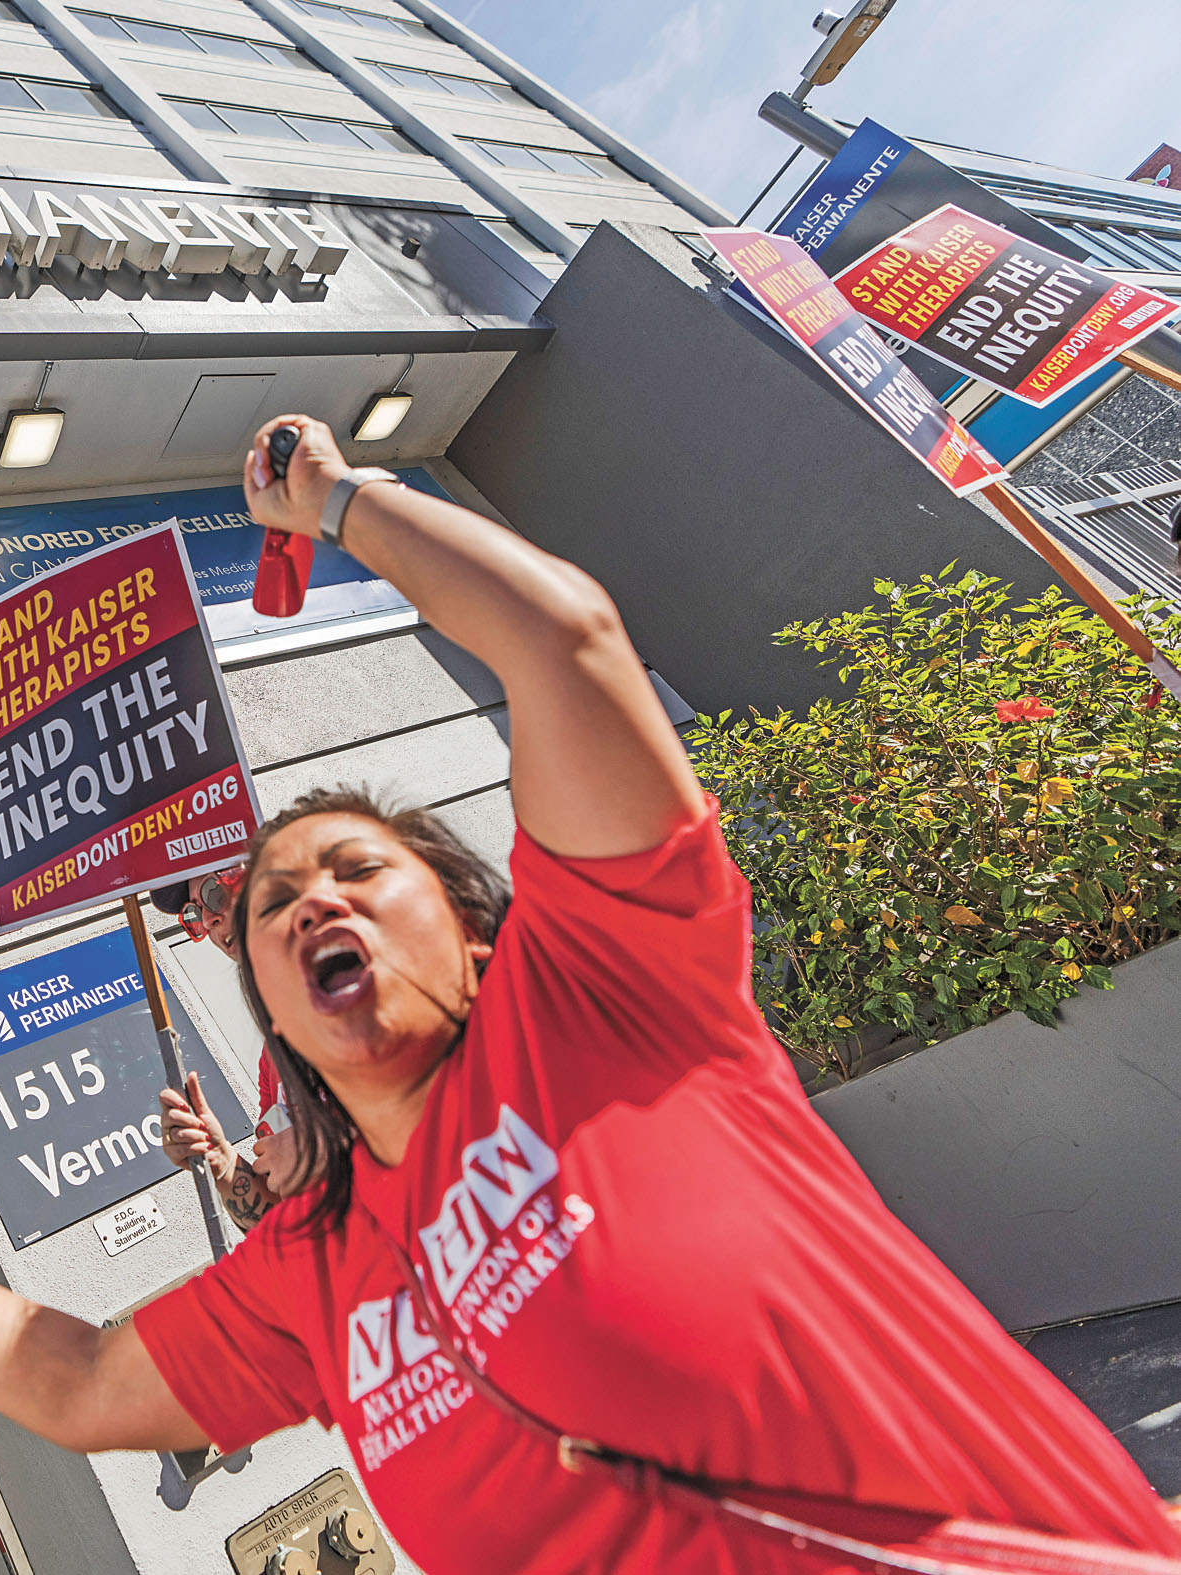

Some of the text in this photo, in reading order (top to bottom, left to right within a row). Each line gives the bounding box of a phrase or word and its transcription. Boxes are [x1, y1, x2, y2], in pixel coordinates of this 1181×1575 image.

[802, 145, 900, 254] PERMANENTE
[731, 239, 782, 277] STAND
[851, 246, 913, 303] STAND
[873, 223, 978, 317] WITH KAISER
[897, 240, 996, 331] THERAPISTS
[757, 269, 804, 307] WITH
[936, 253, 1048, 351] END THE
[973, 263, 1094, 374] INEQUITY
[1028, 285, 1136, 393] KAISERDONTDENY.ORG
[828, 336, 883, 389] END
[208, 560, 257, 577] Medical
[45, 566, 157, 658] KAISER
[82, 656, 177, 741] THE
[12, 776, 240, 912] KAISERDONTDENY.ORG
[165, 821, 248, 861] NUHW
[7, 974, 74, 1010] KAISER
[19, 972, 144, 1033] PERMANENTE
[114, 1207, 137, 1223] F.D.C.
[114, 1219, 158, 1248] Stairwell #2
[115, 1214, 147, 1235] Building
[517, 1194, 556, 1240] OF
[477, 1193, 595, 1338] WORKERS
[263, 1491, 319, 1533] AUTO SPKR
[254, 1538, 271, 1556] FIRE
